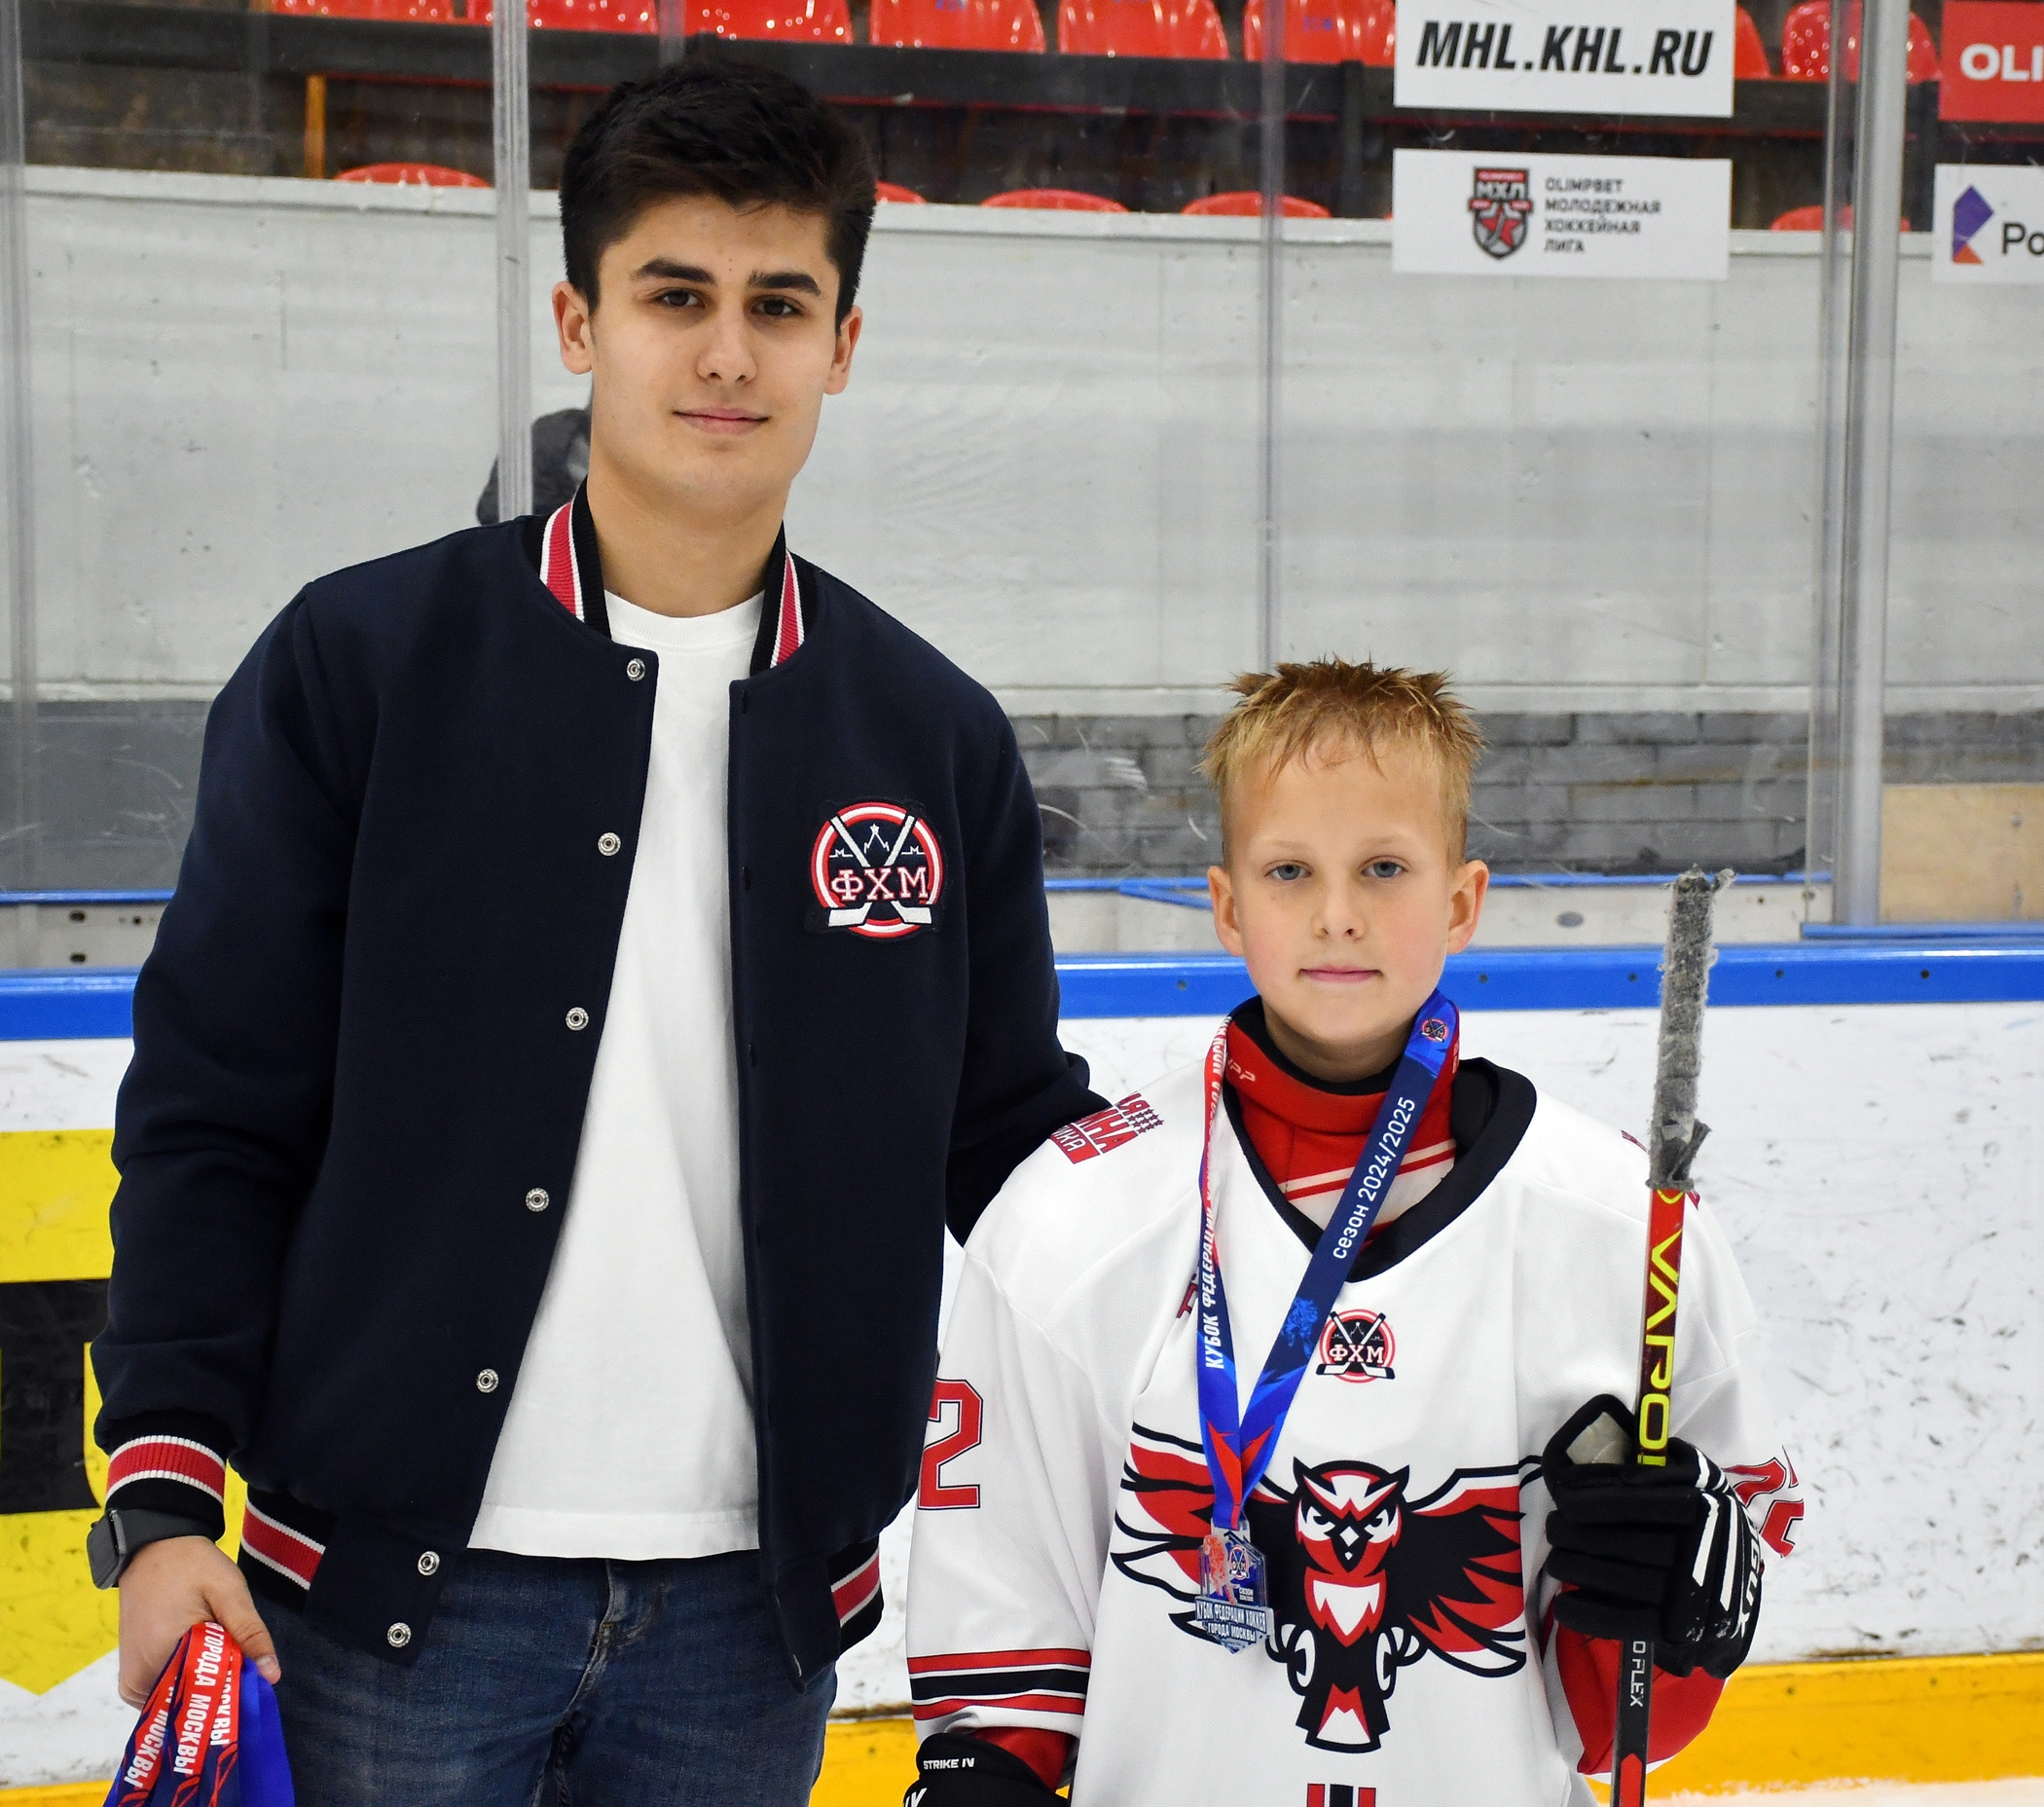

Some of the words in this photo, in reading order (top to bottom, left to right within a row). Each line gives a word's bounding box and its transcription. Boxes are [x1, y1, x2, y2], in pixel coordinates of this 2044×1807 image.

[1416, 20, 1714, 76] MHL.KHL.RU
[1960, 43, 2043, 82] OLI
[1545, 177, 1624, 193] OLIMPBET
[1545, 198, 1661, 214] МОЛОДЕЖНАЯ
[1545, 215, 1641, 234] ХОККЕЙНАЯ
[1545, 239, 1586, 253] ЛИГА
[830, 867, 929, 902] ФХМ
[1332, 1204, 1369, 1259] сезон
[1357, 1096, 1416, 1202] 2024/2025
[1203, 1313, 1224, 1369] КУБОК
[1329, 1344, 1384, 1364] ФХМ
[918, 1378, 984, 1510] 2
[195, 1629, 225, 1686] ГОРОДА
[1629, 1658, 1646, 1708] FLEX
[173, 1693, 211, 1774] МОСКВЫ
[923, 1758, 959, 1770] STRIKE
[962, 1757, 975, 1768] IV
